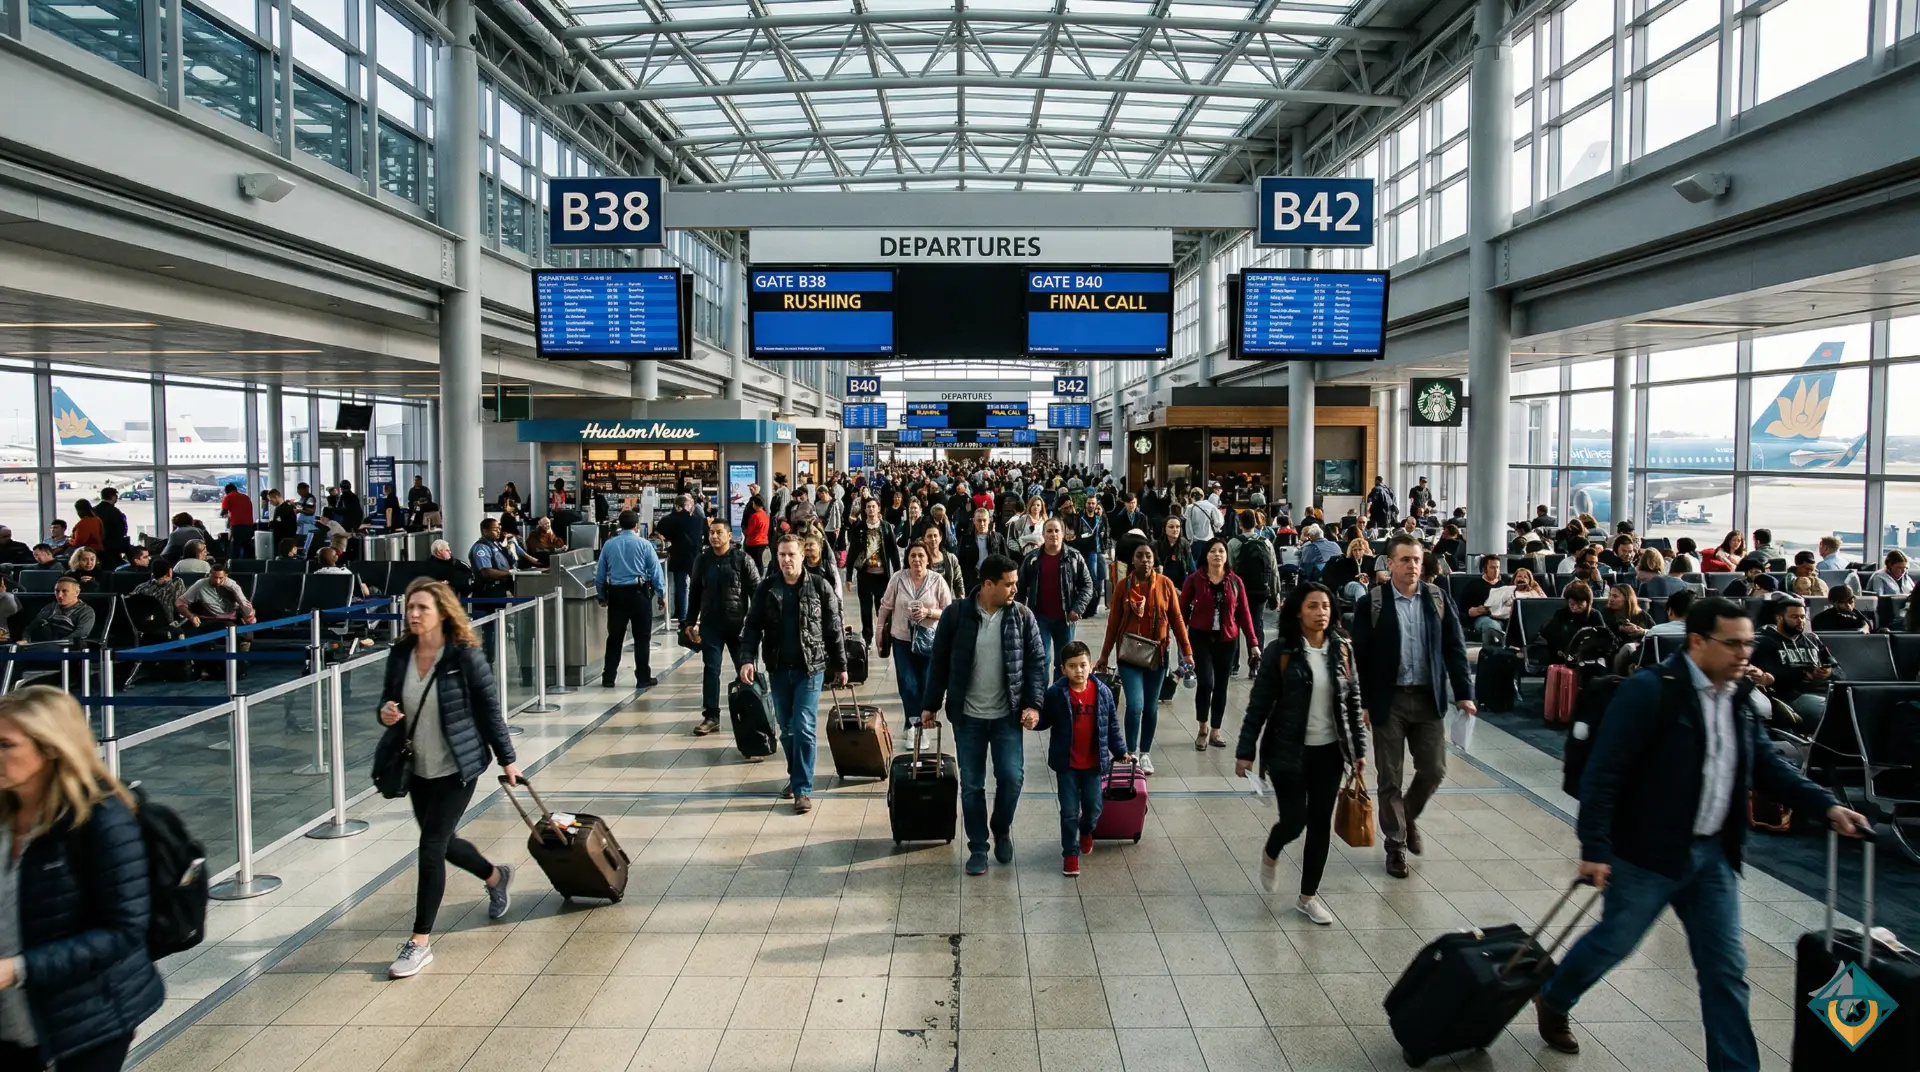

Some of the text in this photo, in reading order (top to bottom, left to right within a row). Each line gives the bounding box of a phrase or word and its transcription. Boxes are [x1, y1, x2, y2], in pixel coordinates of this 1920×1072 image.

[562, 191, 650, 231] B38
[1273, 191, 1361, 231] B42
[880, 237, 1041, 257] DEPARTURES
[755, 275, 826, 288] GATE B38
[1032, 275, 1103, 288] GATE B40
[784, 294, 862, 309] RUSHING
[1050, 294, 1147, 310] FINAL CALL
[850, 380, 877, 393] B40
[1057, 380, 1085, 393] B42
[941, 392, 993, 401] DEPARTURES
[580, 423, 700, 438] Hudson News
